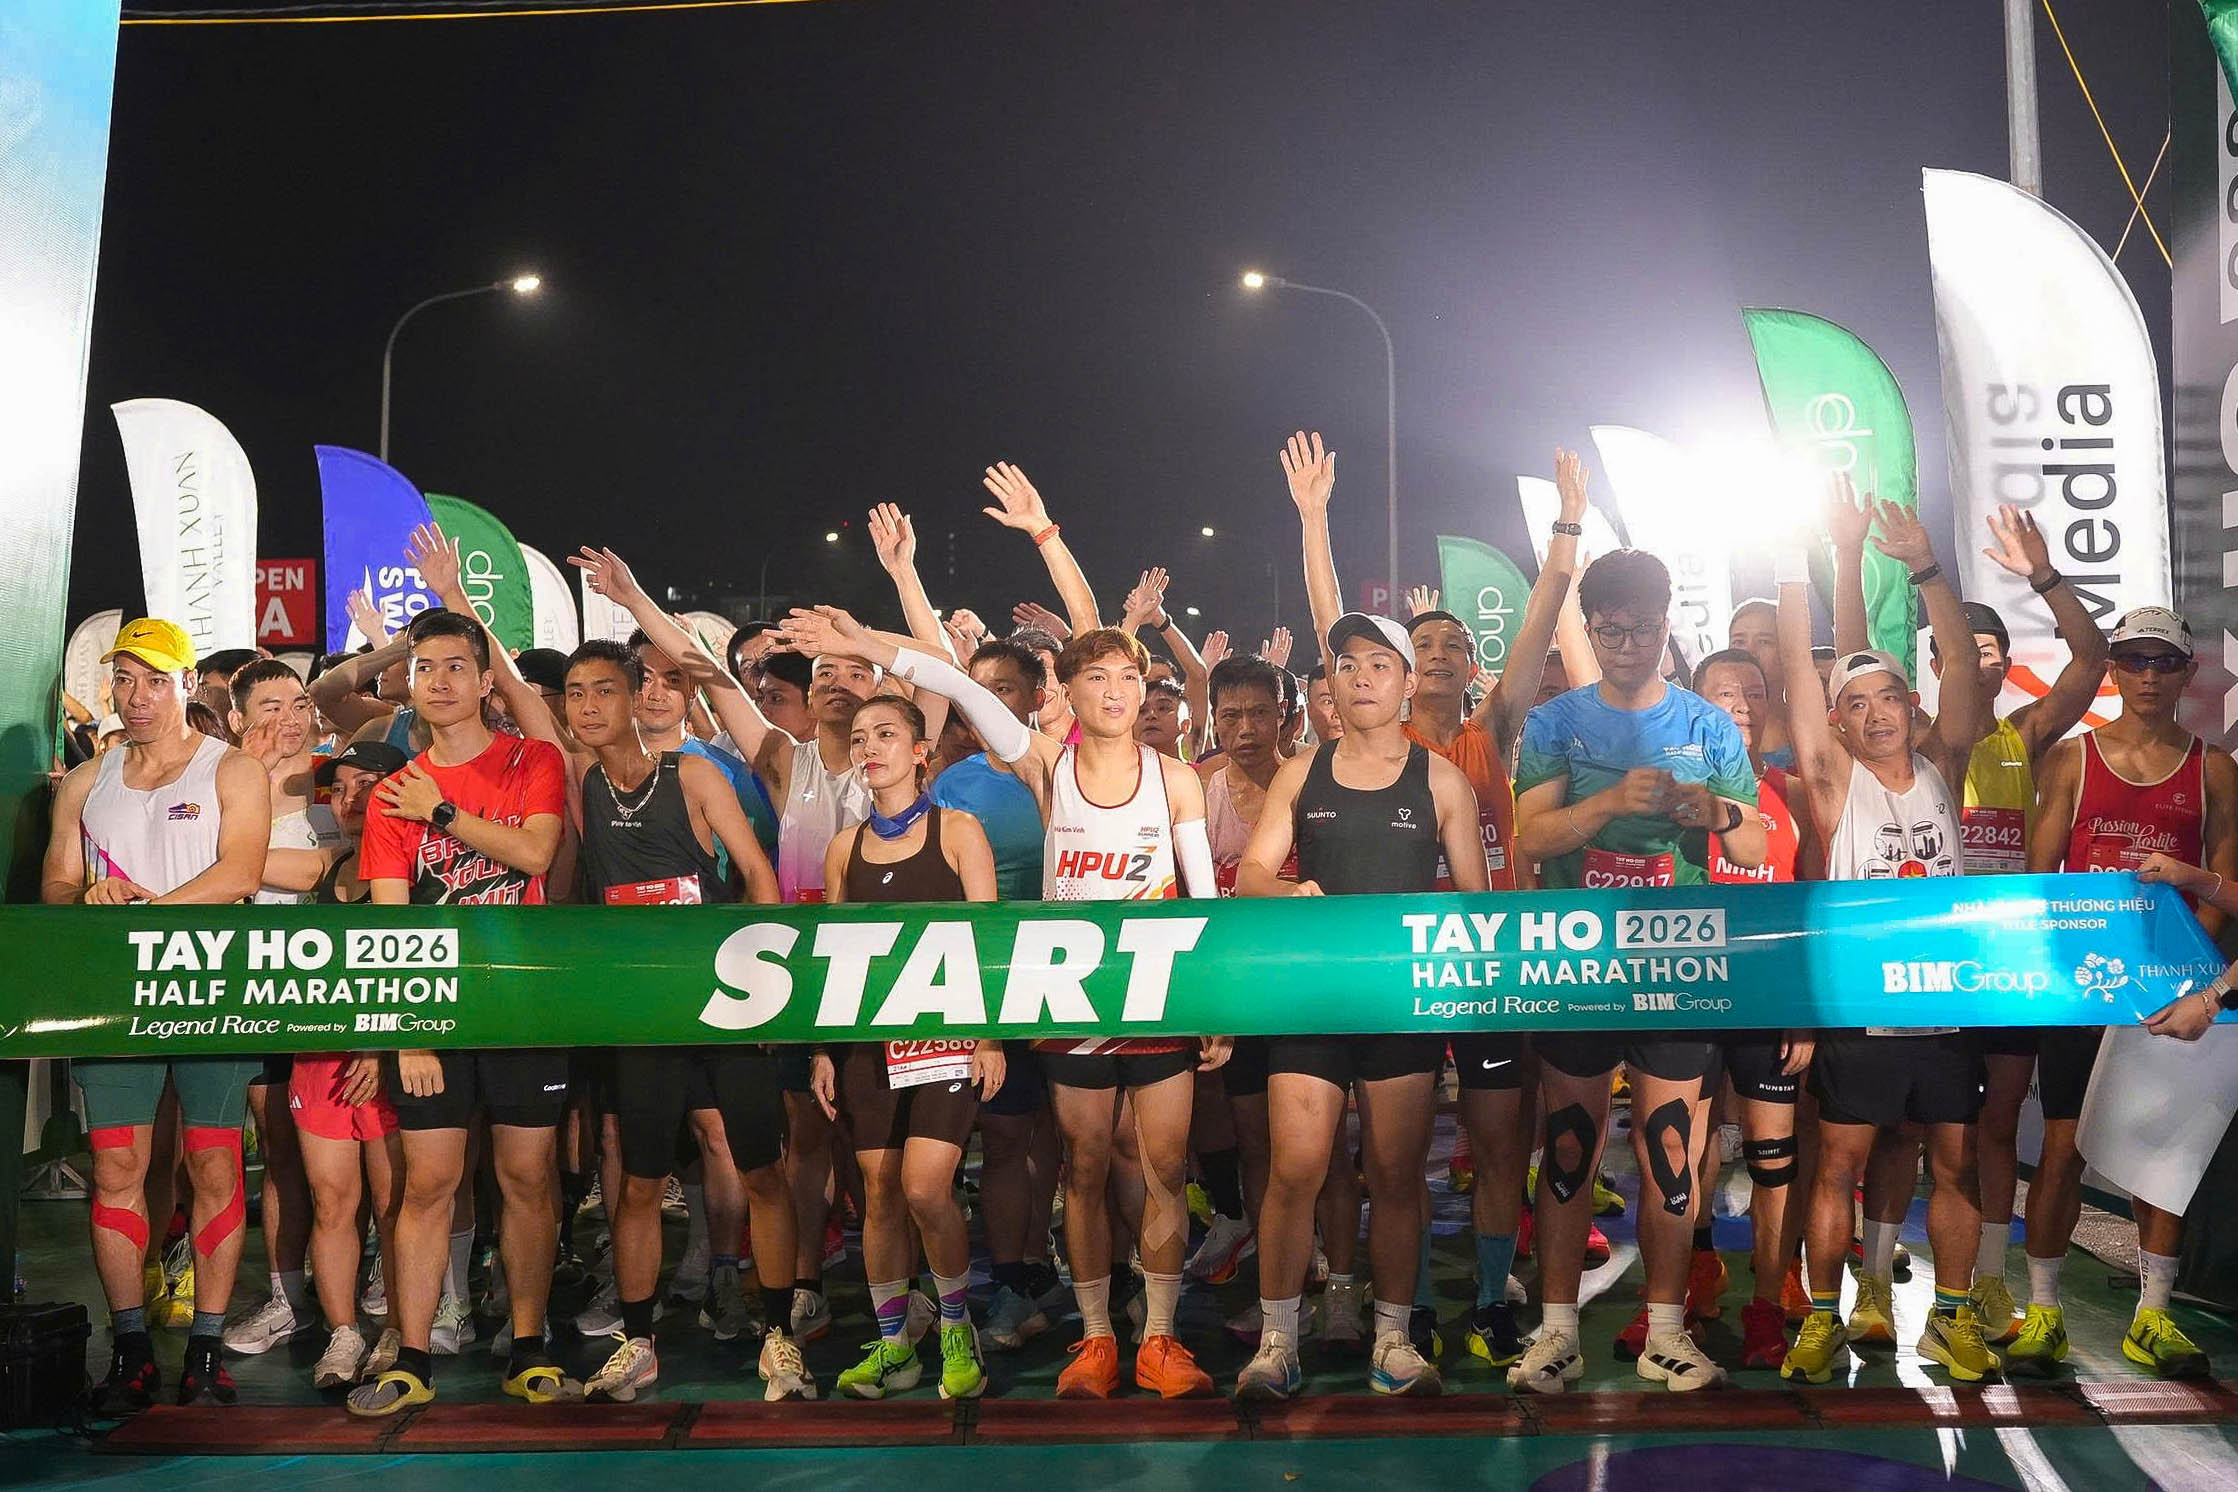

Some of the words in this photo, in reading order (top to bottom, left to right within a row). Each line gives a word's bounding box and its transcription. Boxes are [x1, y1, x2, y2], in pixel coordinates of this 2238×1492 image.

[2041, 384, 2121, 638] Media
[1306, 811, 1337, 819] SUUNTO
[1391, 821, 1417, 830] motive
[2088, 817, 2139, 833] Passion
[1056, 850, 1152, 881] HPU2
[1402, 913, 1507, 953] TAY
[1520, 910, 1603, 951] HO
[1626, 914, 1717, 943] 2026
[2041, 919, 2107, 929] SPONSOR
[128, 930, 235, 971] TAY
[248, 929, 333, 971] HO
[357, 935, 448, 963] 2026
[700, 917, 1209, 1030] START
[1412, 961, 1501, 987] HALF
[1520, 957, 1728, 985] MARATHON
[2138, 964, 2193, 978] THANH
[134, 979, 226, 1006] HALF
[243, 977, 458, 1005] MARATHON
[1413, 997, 1497, 1019] Legend
[1504, 996, 1559, 1014] Race
[1568, 1002, 1610, 1011] Powered
[1613, 1002, 1625, 1012] by
[128, 1016, 216, 1039] Legend
[221, 1015, 280, 1034] Race
[287, 1023, 331, 1032] Powered
[334, 1022, 347, 1033] by
